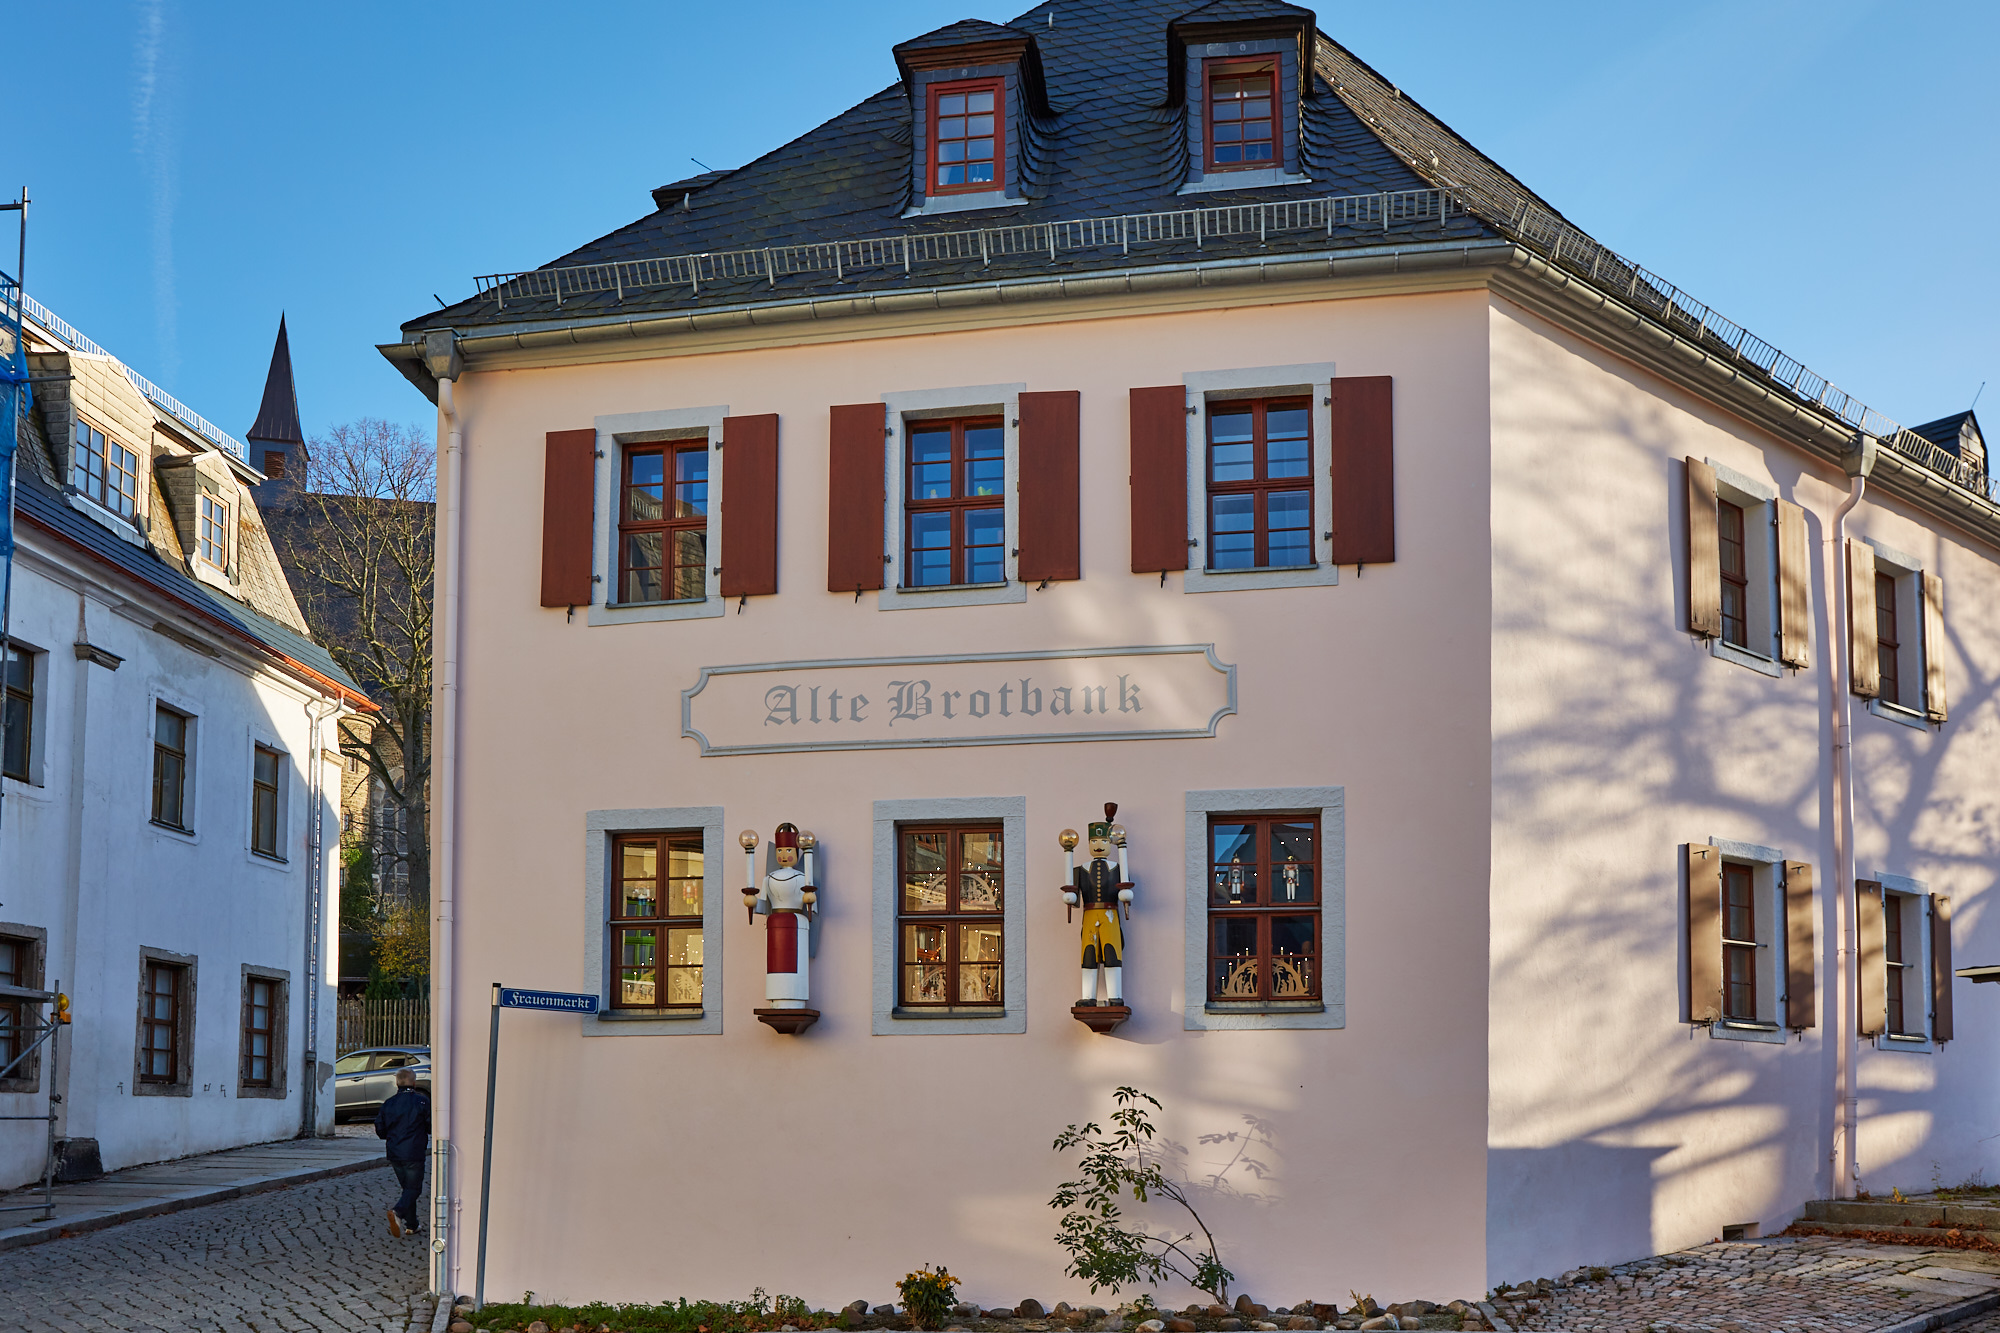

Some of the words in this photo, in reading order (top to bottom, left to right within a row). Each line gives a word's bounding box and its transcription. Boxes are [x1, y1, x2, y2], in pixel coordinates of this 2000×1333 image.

[763, 684, 869, 727] Alte
[887, 674, 1144, 727] Brotbank
[509, 992, 589, 1008] Frauenmarkt
